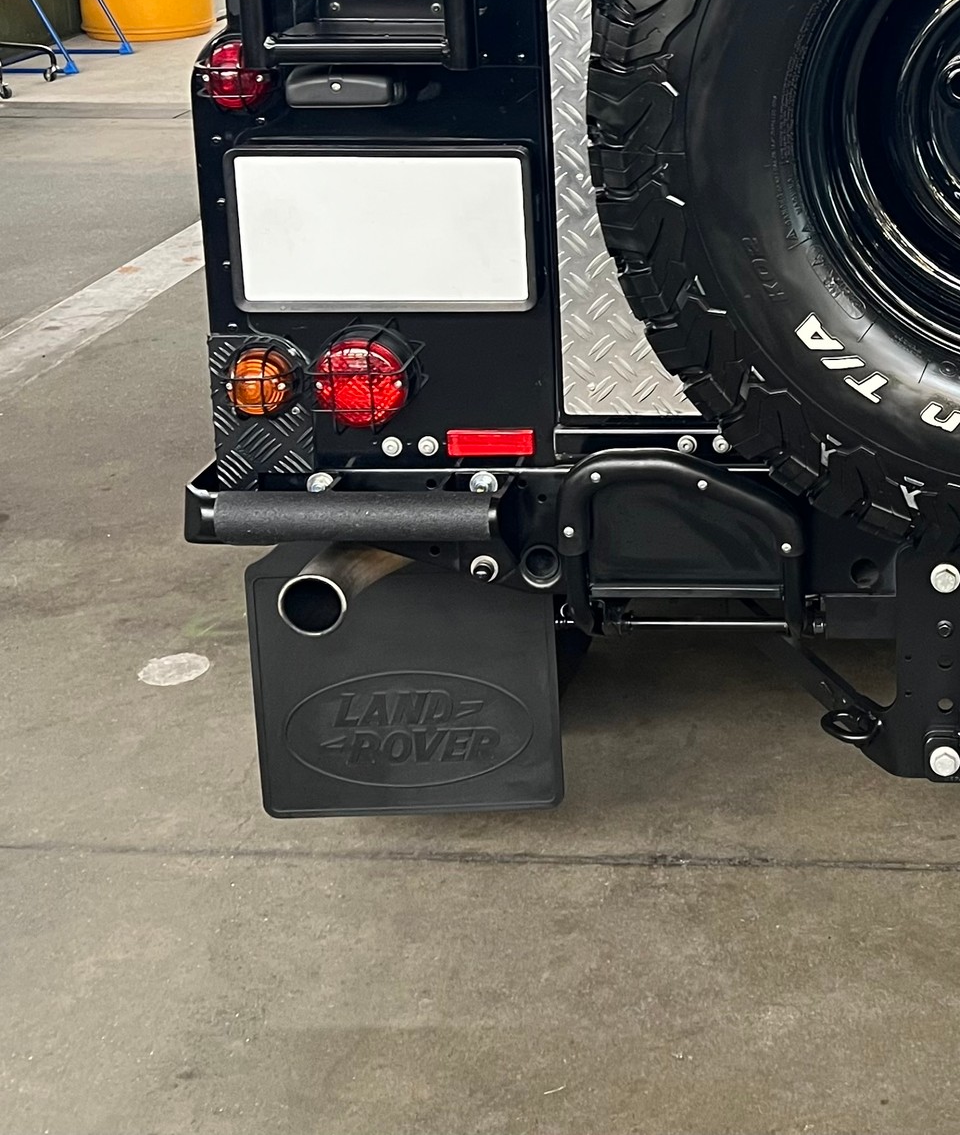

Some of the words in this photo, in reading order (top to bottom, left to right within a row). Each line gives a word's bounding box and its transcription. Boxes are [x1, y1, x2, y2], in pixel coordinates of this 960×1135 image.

[795, 312, 890, 404] T/A
[332, 689, 453, 728] LAND
[345, 726, 501, 765] ROVER
